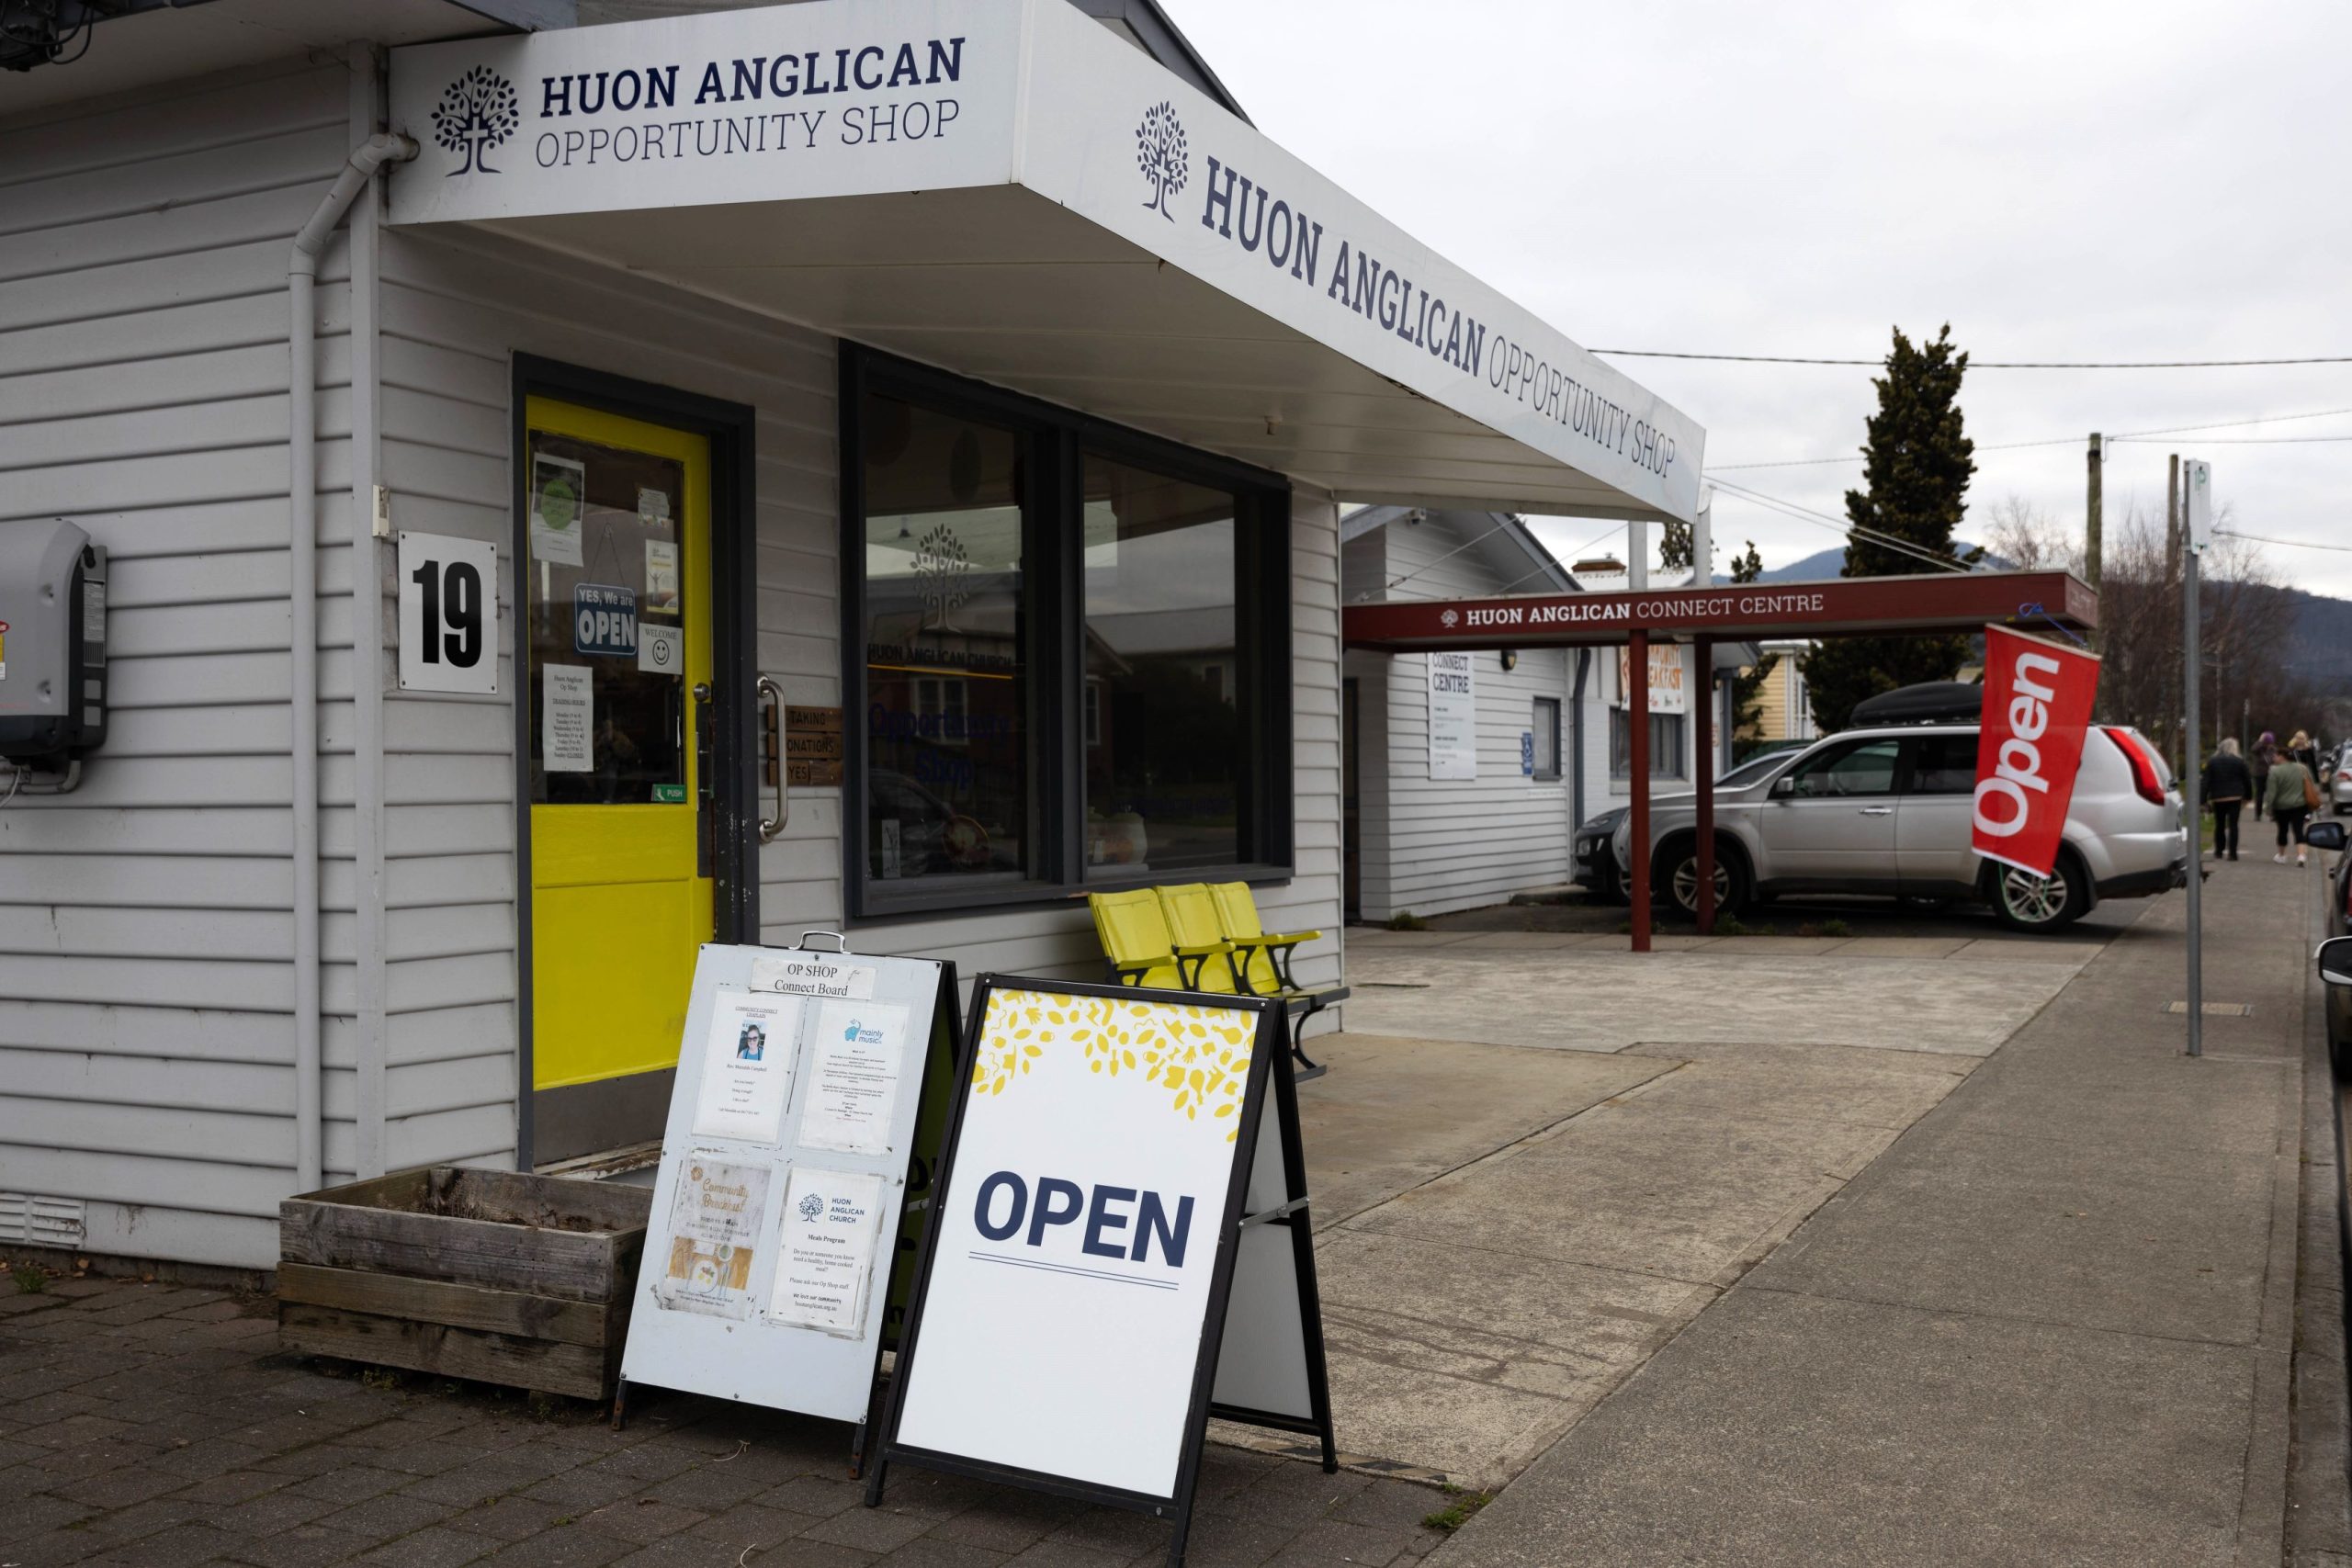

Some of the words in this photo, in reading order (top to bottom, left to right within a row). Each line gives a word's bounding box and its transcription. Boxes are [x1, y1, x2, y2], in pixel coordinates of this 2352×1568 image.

[539, 63, 680, 118] HUON
[695, 37, 966, 106] ANGLICAN
[536, 109, 826, 167] OPPORTUNITY
[841, 98, 959, 145] SHOP
[1202, 155, 1323, 287] HUON
[1328, 241, 1486, 378] ANGLICAN
[1489, 335, 1631, 454] OPPORTUNITY
[1632, 420, 1675, 479] SHOP
[579, 589, 602, 606] YES,
[605, 591, 618, 605] We
[620, 596, 633, 606] are
[413, 559, 481, 668] 19
[1466, 607, 1522, 625] HUON
[1529, 604, 1631, 624] ANGLICAN
[1636, 598, 1735, 618] CONNECT
[1739, 594, 1824, 614] CENTRE
[578, 609, 636, 647] OPEN
[645, 628, 677, 640] WELCOME
[867, 643, 902, 660] HUON
[904, 648, 966, 664] ANGLICAN
[1433, 652, 1468, 671] CONNECT
[1433, 672, 1469, 694] CENTRE
[790, 711, 826, 725] TAKING
[786, 739, 834, 752] ONATIONS
[1973, 652, 2061, 837] Open
[788, 766, 807, 780] YES
[914, 748, 971, 790] Shop
[667, 789, 683, 798] PUSH
[787, 964, 804, 976] OP
[806, 965, 838, 978] SHOP
[775, 979, 815, 993] Connect
[818, 983, 848, 997] Board
[858, 1036, 879, 1044] music
[859, 1030, 884, 1039] mainly
[702, 1178, 750, 1200] Community
[829, 1214, 856, 1224] CHURCH
[830, 1206, 865, 1216] ANGLICAN
[973, 1170, 1194, 1269] OPEN
[808, 1234, 822, 1242] Meals
[823, 1235, 846, 1244] Program
[827, 1281, 840, 1291] Shop
